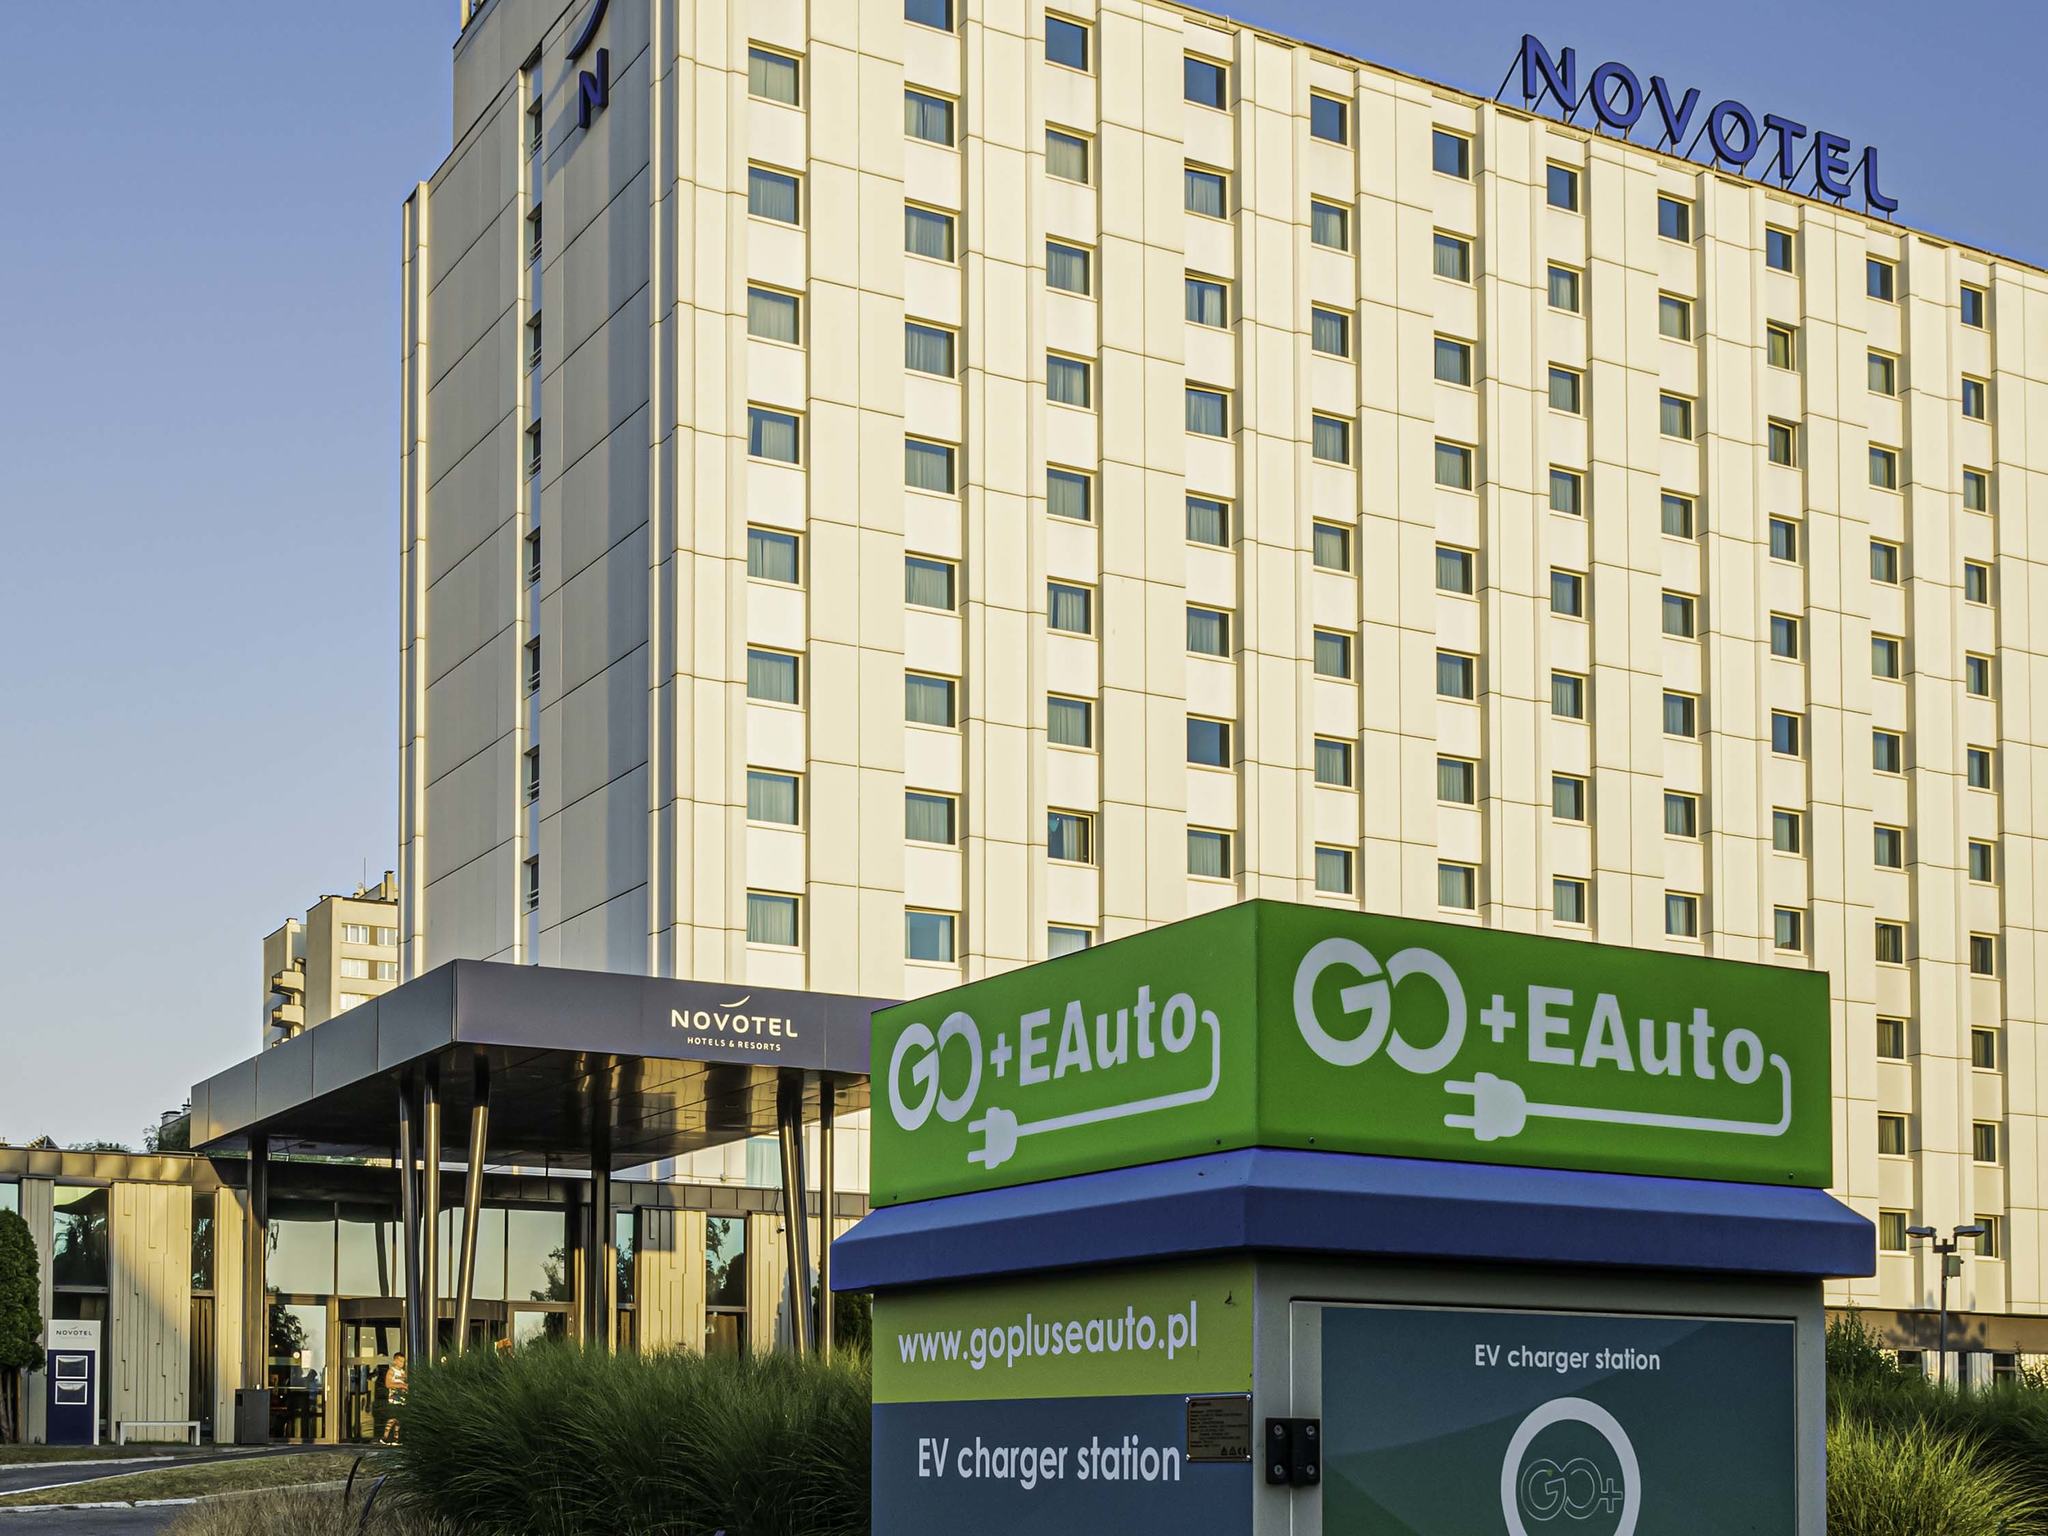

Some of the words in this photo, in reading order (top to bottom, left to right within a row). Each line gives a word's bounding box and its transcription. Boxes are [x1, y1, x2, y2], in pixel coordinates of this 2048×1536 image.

[579, 47, 609, 129] N
[1521, 33, 1898, 212] NOVOTEL
[671, 1009, 798, 1037] NOVOTEL
[687, 1036, 726, 1047] HOTELS
[728, 1040, 735, 1048] &
[737, 1040, 781, 1052] RESORTS
[898, 1300, 1197, 1370] www.gopluseauto.pl
[1475, 1344, 1500, 1367] EV
[1507, 1345, 1590, 1373] charger
[1595, 1348, 1661, 1370] station
[918, 1437, 949, 1478] EV
[957, 1436, 1069, 1490] charger
[1077, 1434, 1181, 1481] station
